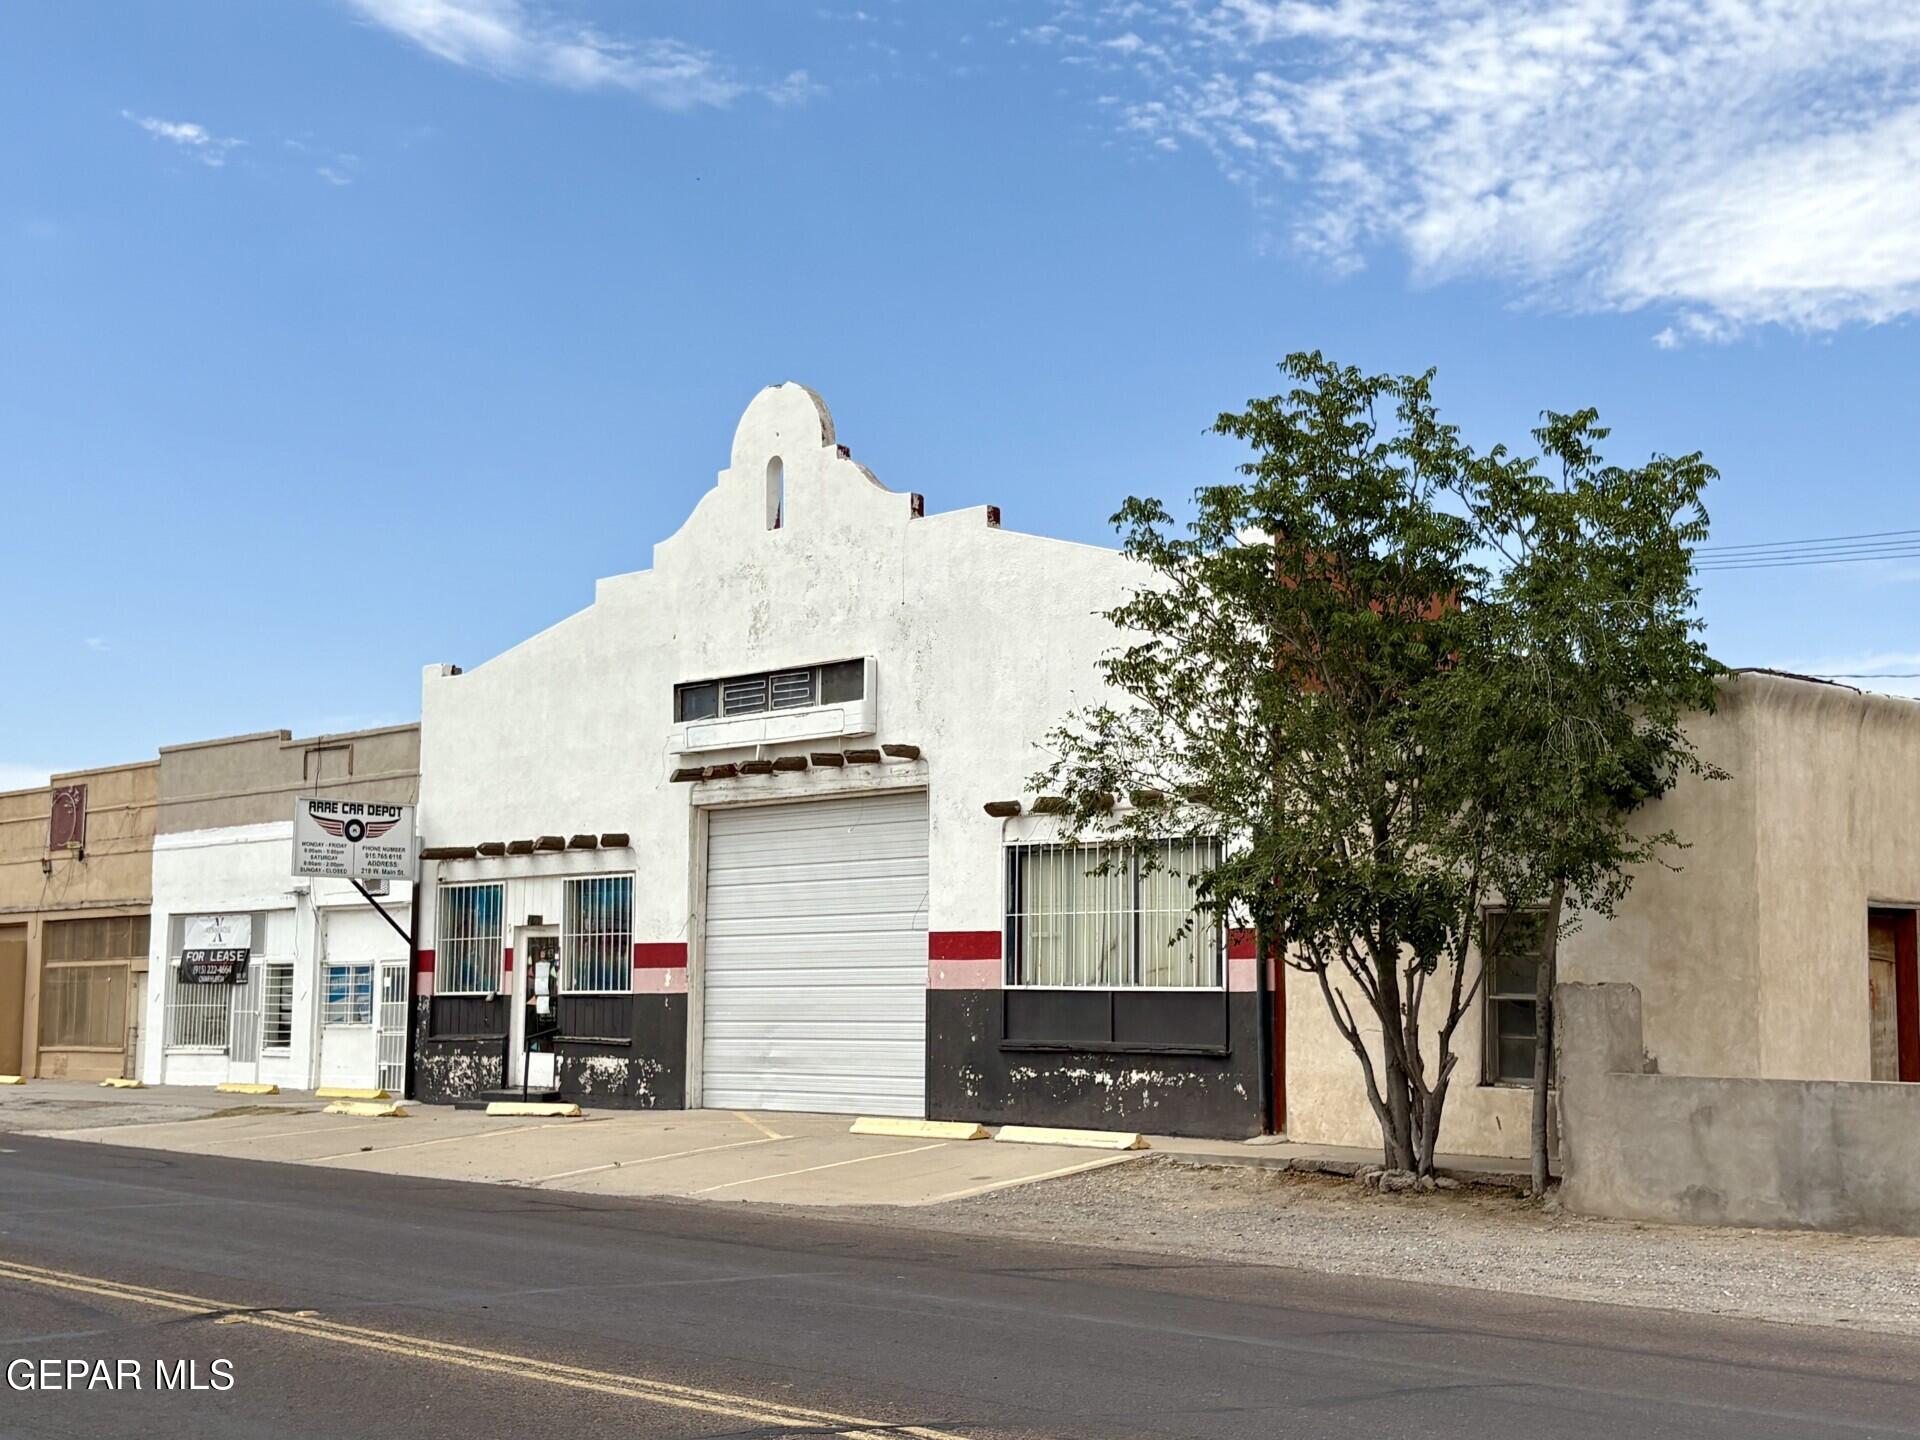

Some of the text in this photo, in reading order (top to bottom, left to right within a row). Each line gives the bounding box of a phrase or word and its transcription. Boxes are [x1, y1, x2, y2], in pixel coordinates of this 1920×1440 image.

[342, 803, 364, 815] CAR
[367, 804, 403, 817] DEPOT
[367, 860, 398, 868] ADDRESS
[382, 868, 397, 876] Main
[186, 950, 245, 962] FOR LEASE
